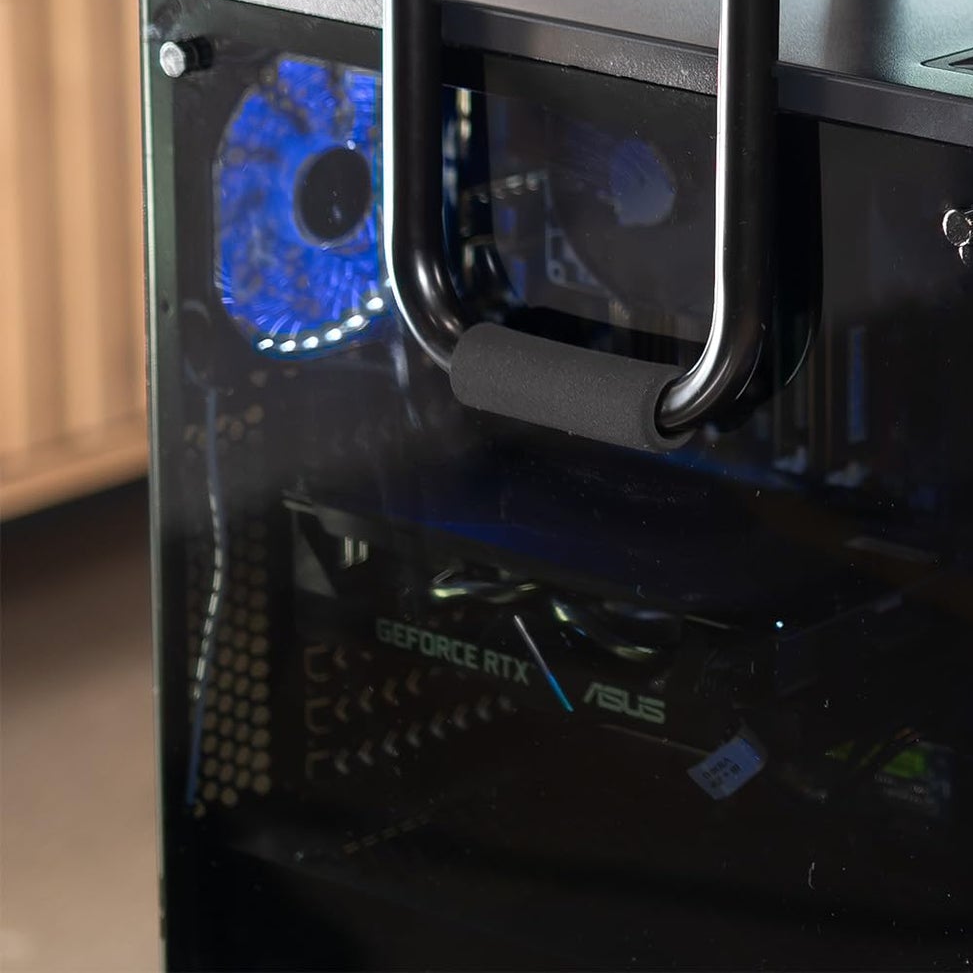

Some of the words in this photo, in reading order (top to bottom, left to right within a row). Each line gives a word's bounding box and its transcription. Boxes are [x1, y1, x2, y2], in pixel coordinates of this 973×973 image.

[375, 617, 479, 670] GEFORCE
[483, 649, 530, 686] RTX
[582, 681, 666, 725] ASUS
